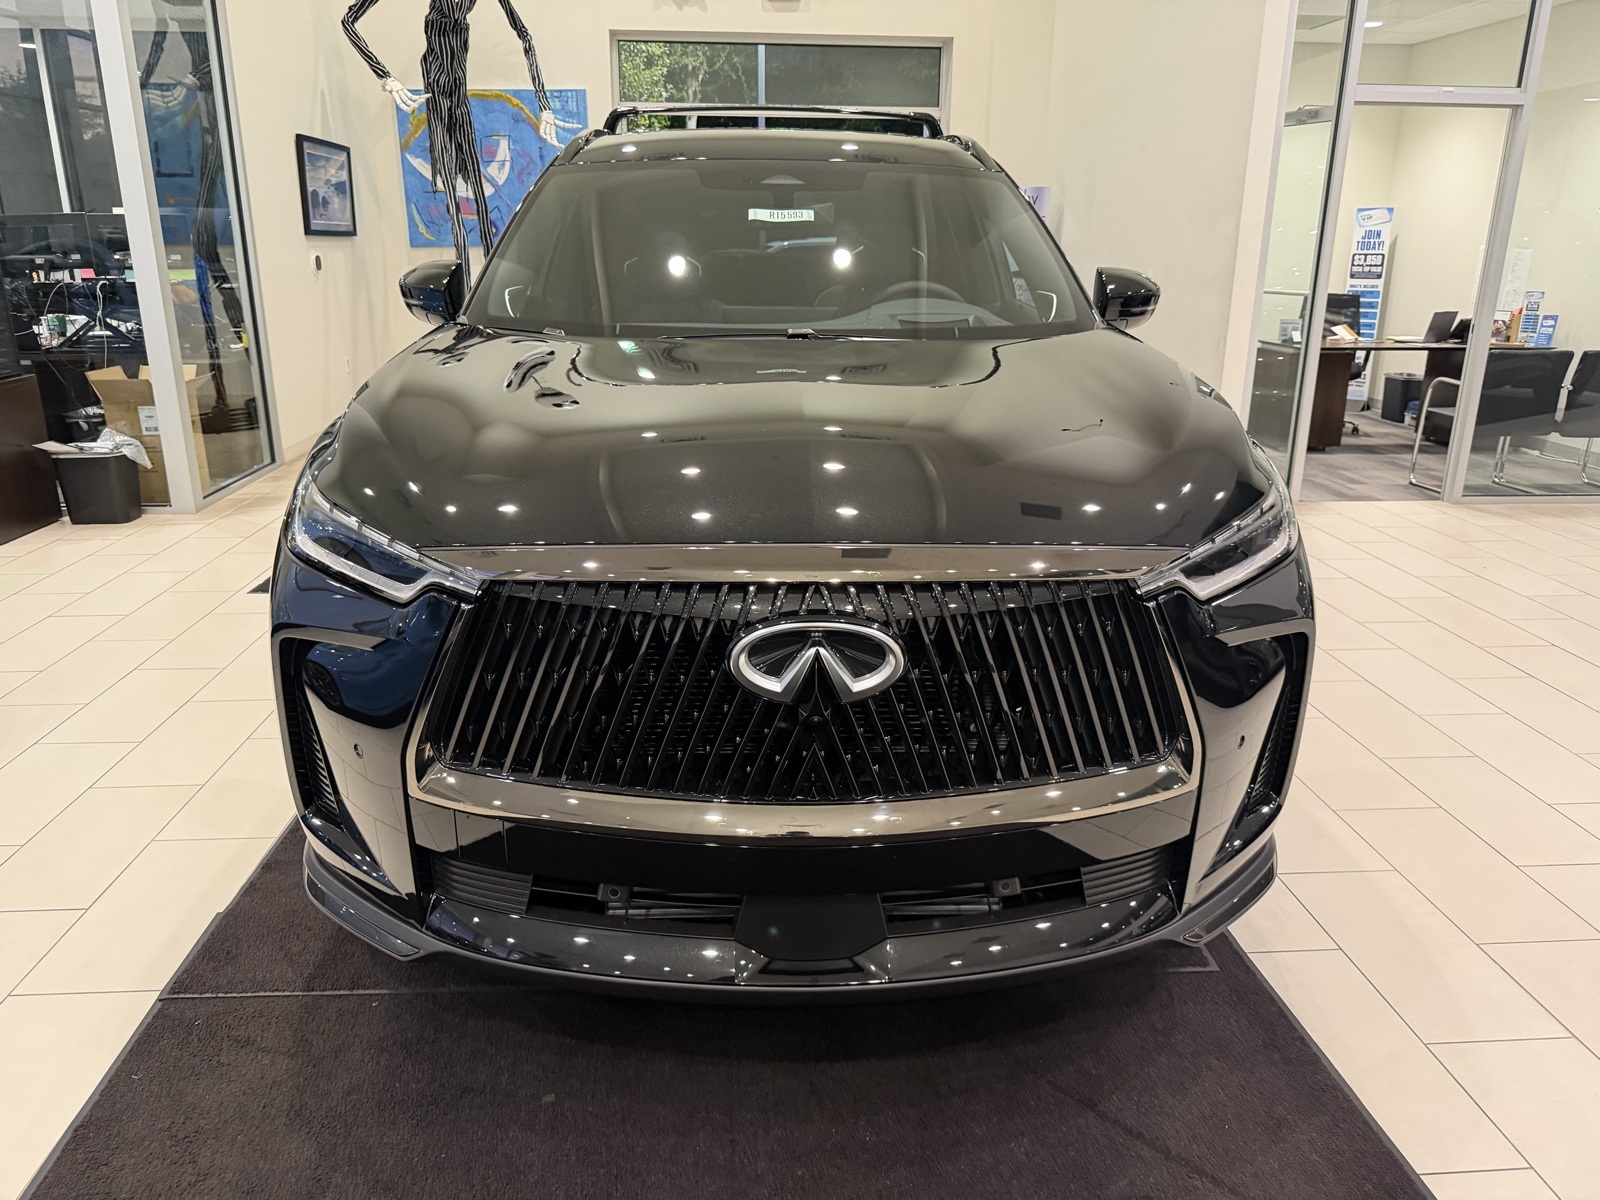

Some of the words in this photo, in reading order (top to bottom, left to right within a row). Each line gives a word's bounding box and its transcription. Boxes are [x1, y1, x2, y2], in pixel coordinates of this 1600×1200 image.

[769, 211, 803, 219] R15593
[1361, 230, 1381, 239] JOIN
[1356, 241, 1384, 251] TODAY!
[1353, 255, 1382, 266] $3,850
